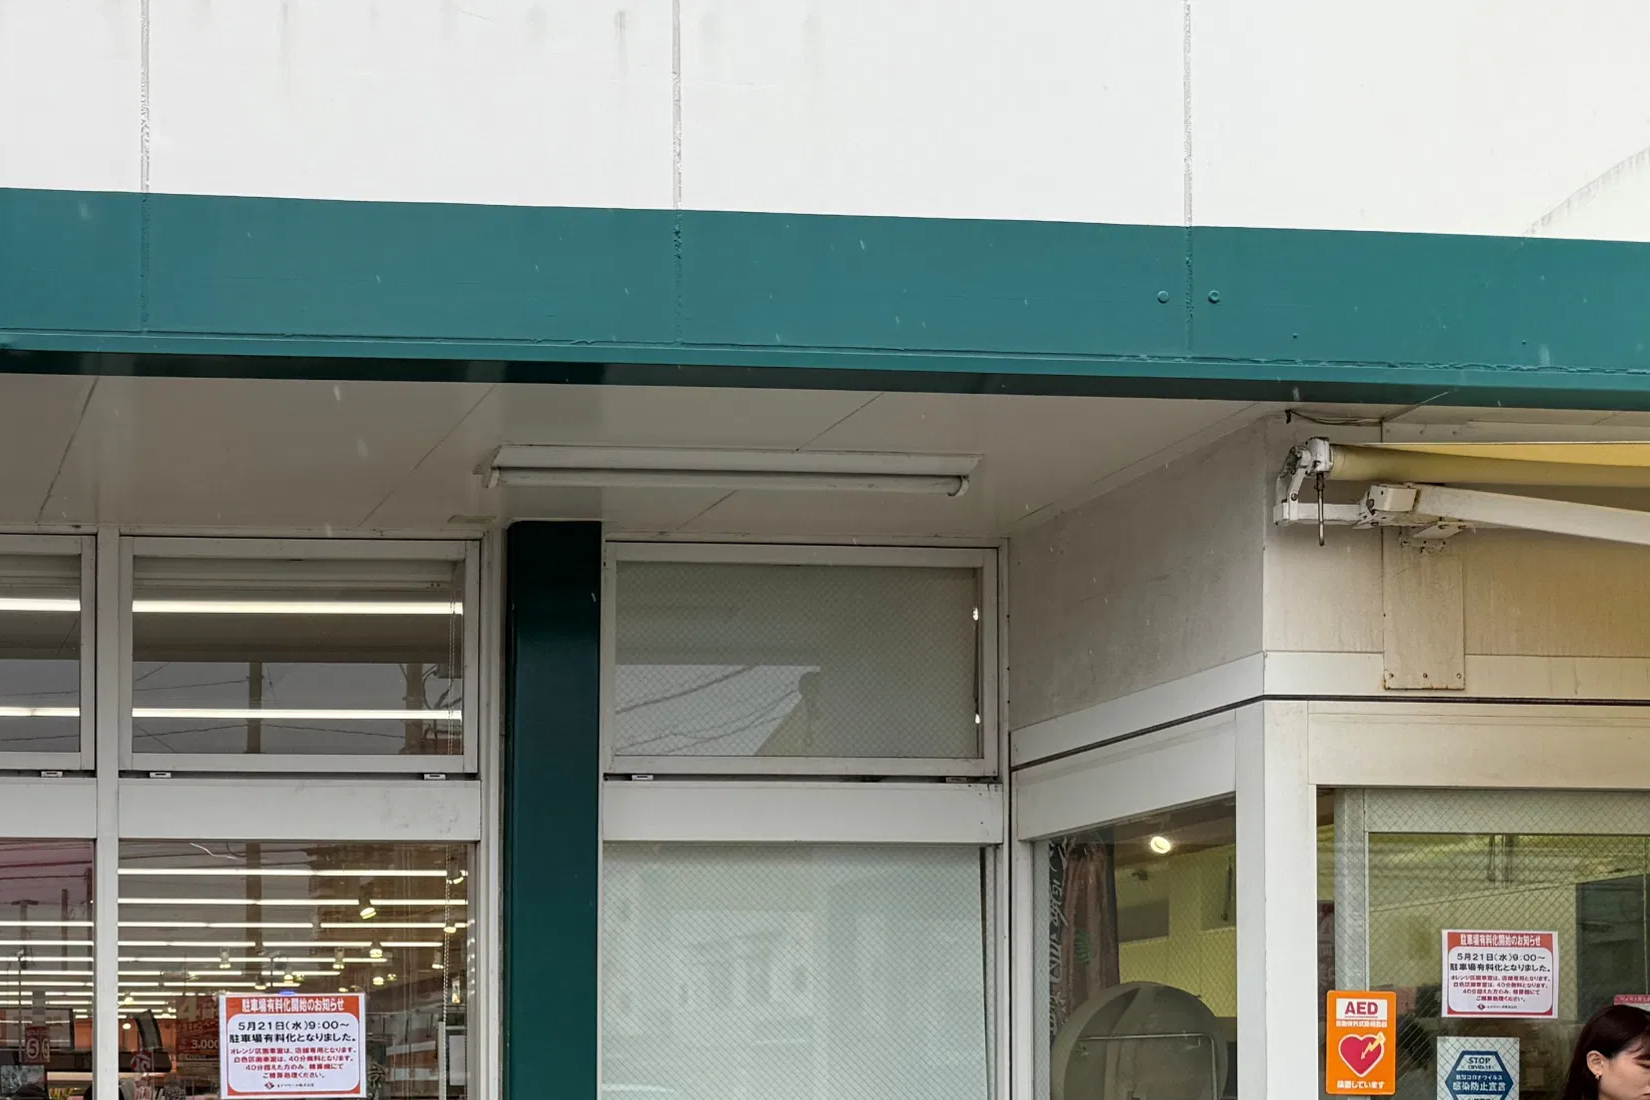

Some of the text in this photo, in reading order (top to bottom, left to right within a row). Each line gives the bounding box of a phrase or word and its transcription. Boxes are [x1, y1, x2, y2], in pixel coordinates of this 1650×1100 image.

[1460, 933, 1541, 947] 駐車場有料化開始のお知らせ
[1449, 963, 1551, 972] 駐車場有料化となりました。
[241, 998, 345, 1013] 駐車場有料化開始のお知らせ
[1344, 1001, 1379, 1015] AED
[229, 1033, 356, 1044] 駐車場有料化となりました。
[1468, 1056, 1491, 1065] STOP
[1452, 1081, 1507, 1092] 感染防止宣言
